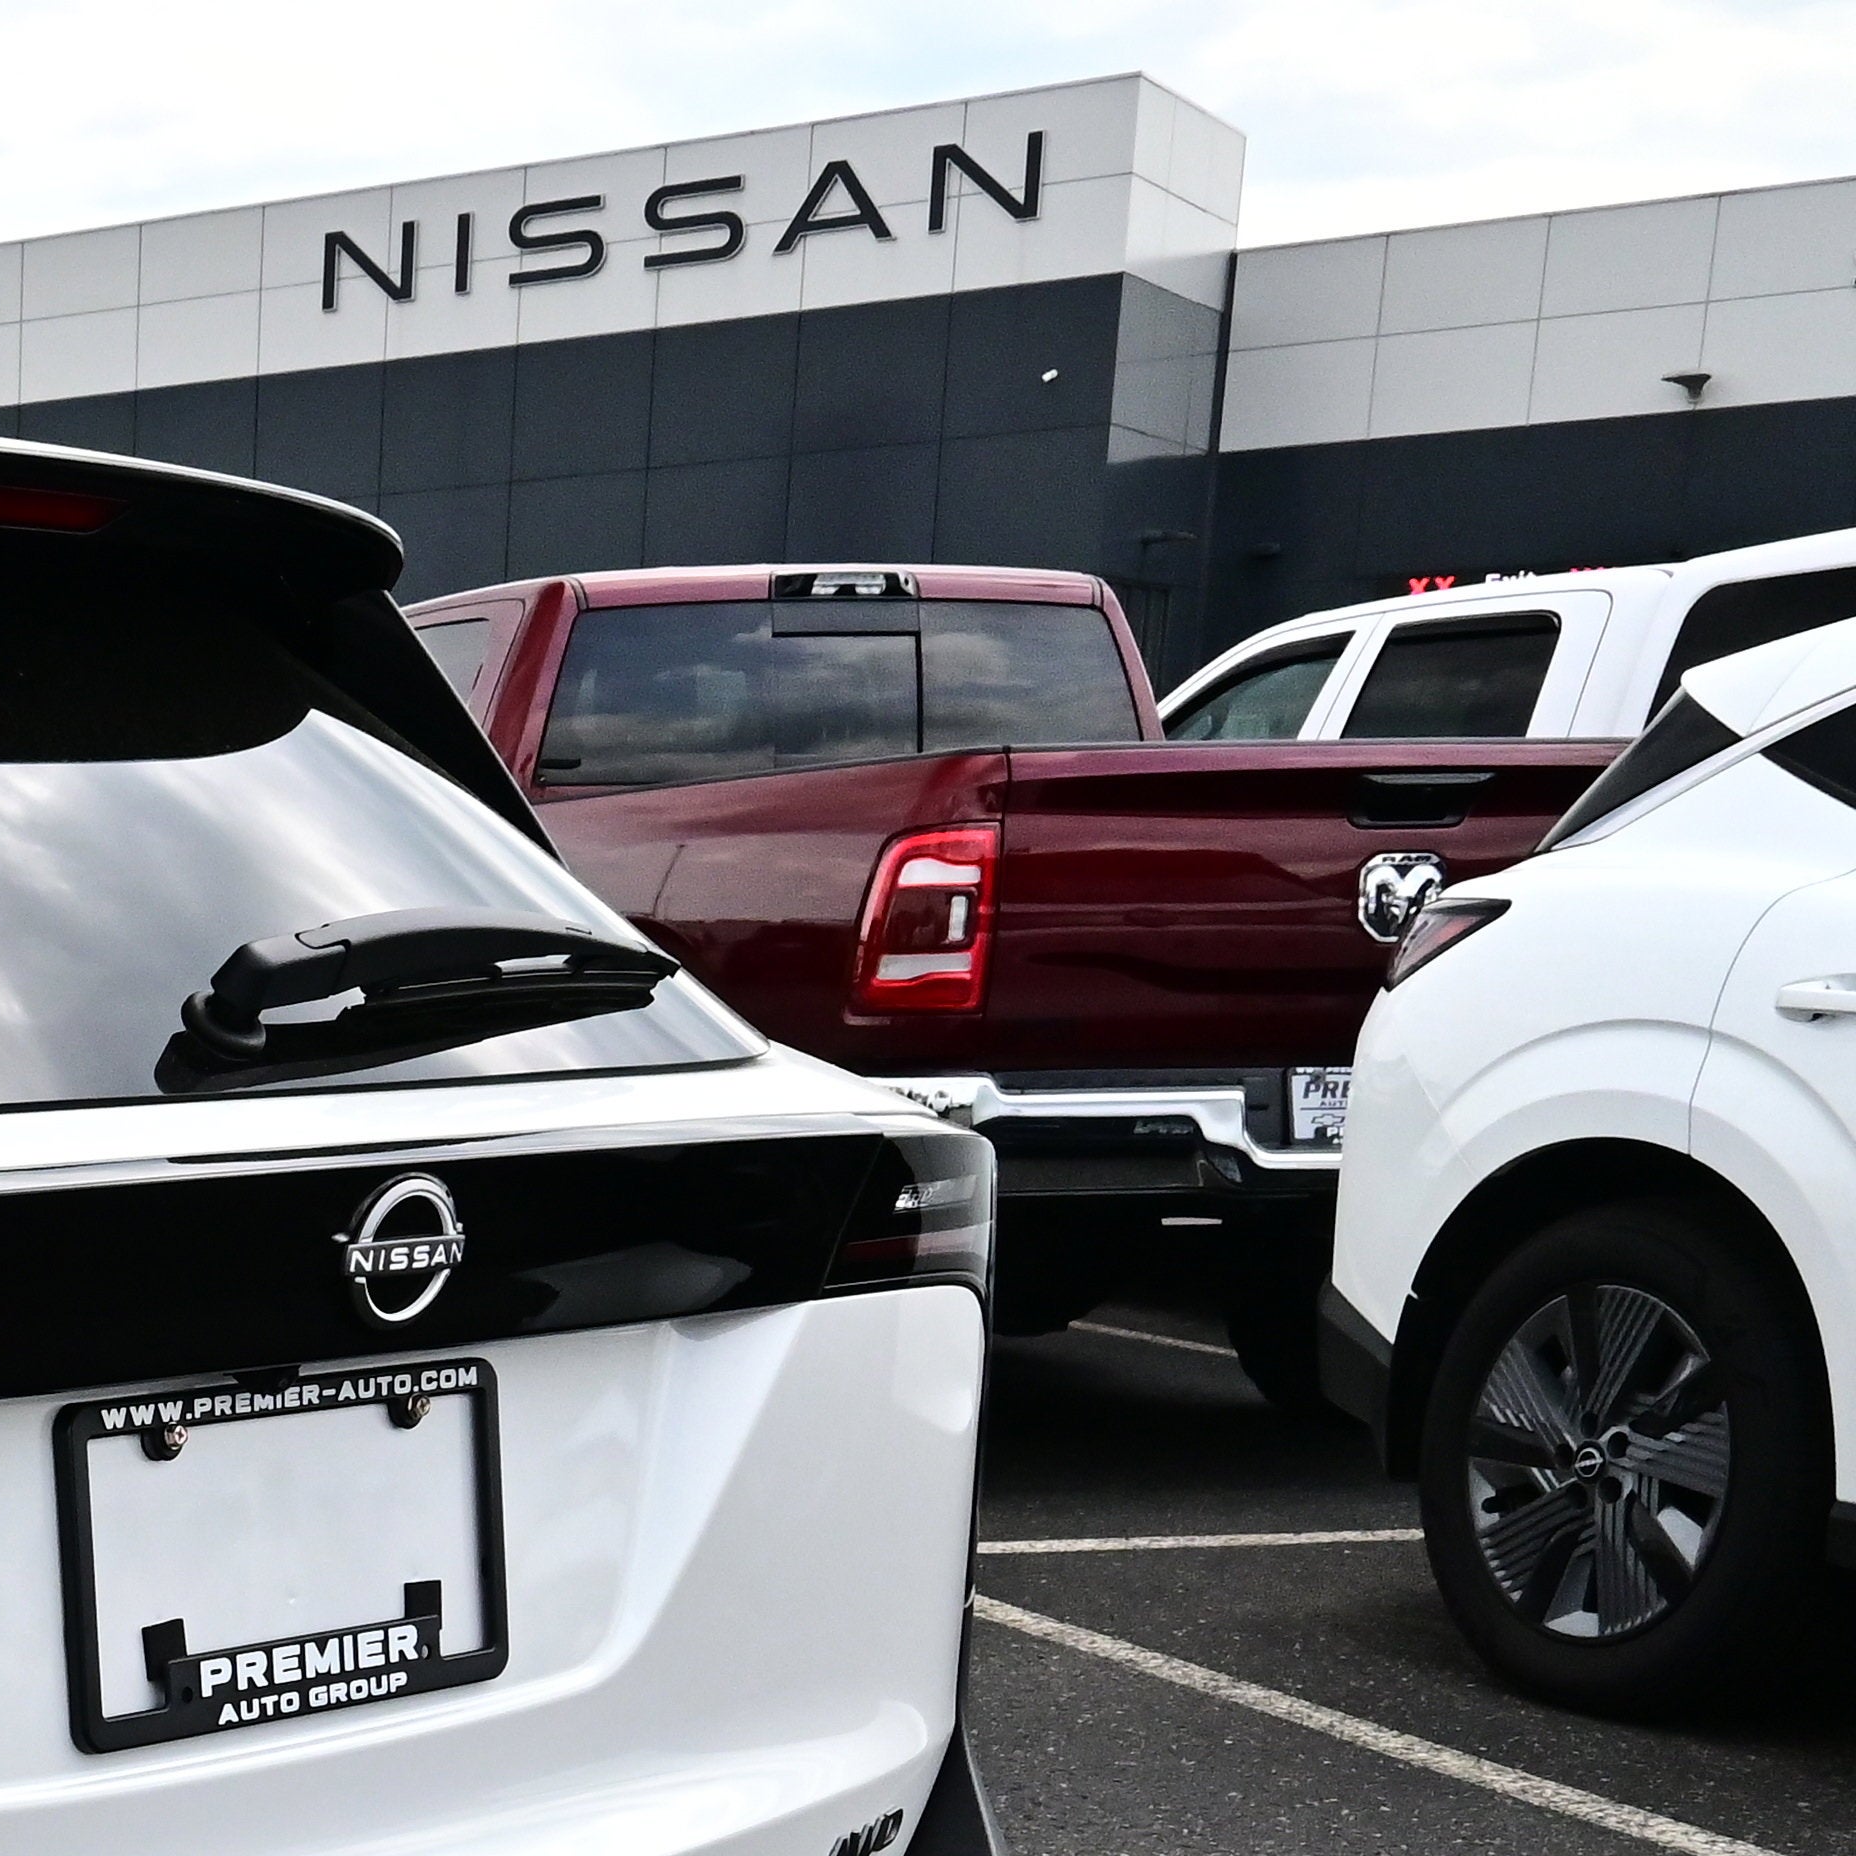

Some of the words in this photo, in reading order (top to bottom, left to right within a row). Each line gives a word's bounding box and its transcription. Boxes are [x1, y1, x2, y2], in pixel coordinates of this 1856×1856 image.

[321, 130, 1045, 312] NISSAN
[349, 1241, 464, 1272] NISSAN
[101, 1367, 478, 1430] WWW.PREMIER-AUTO.COM
[199, 1624, 419, 1698] PREMIER
[218, 1691, 300, 1726] AUTO
[308, 1671, 408, 1708] GROUP
